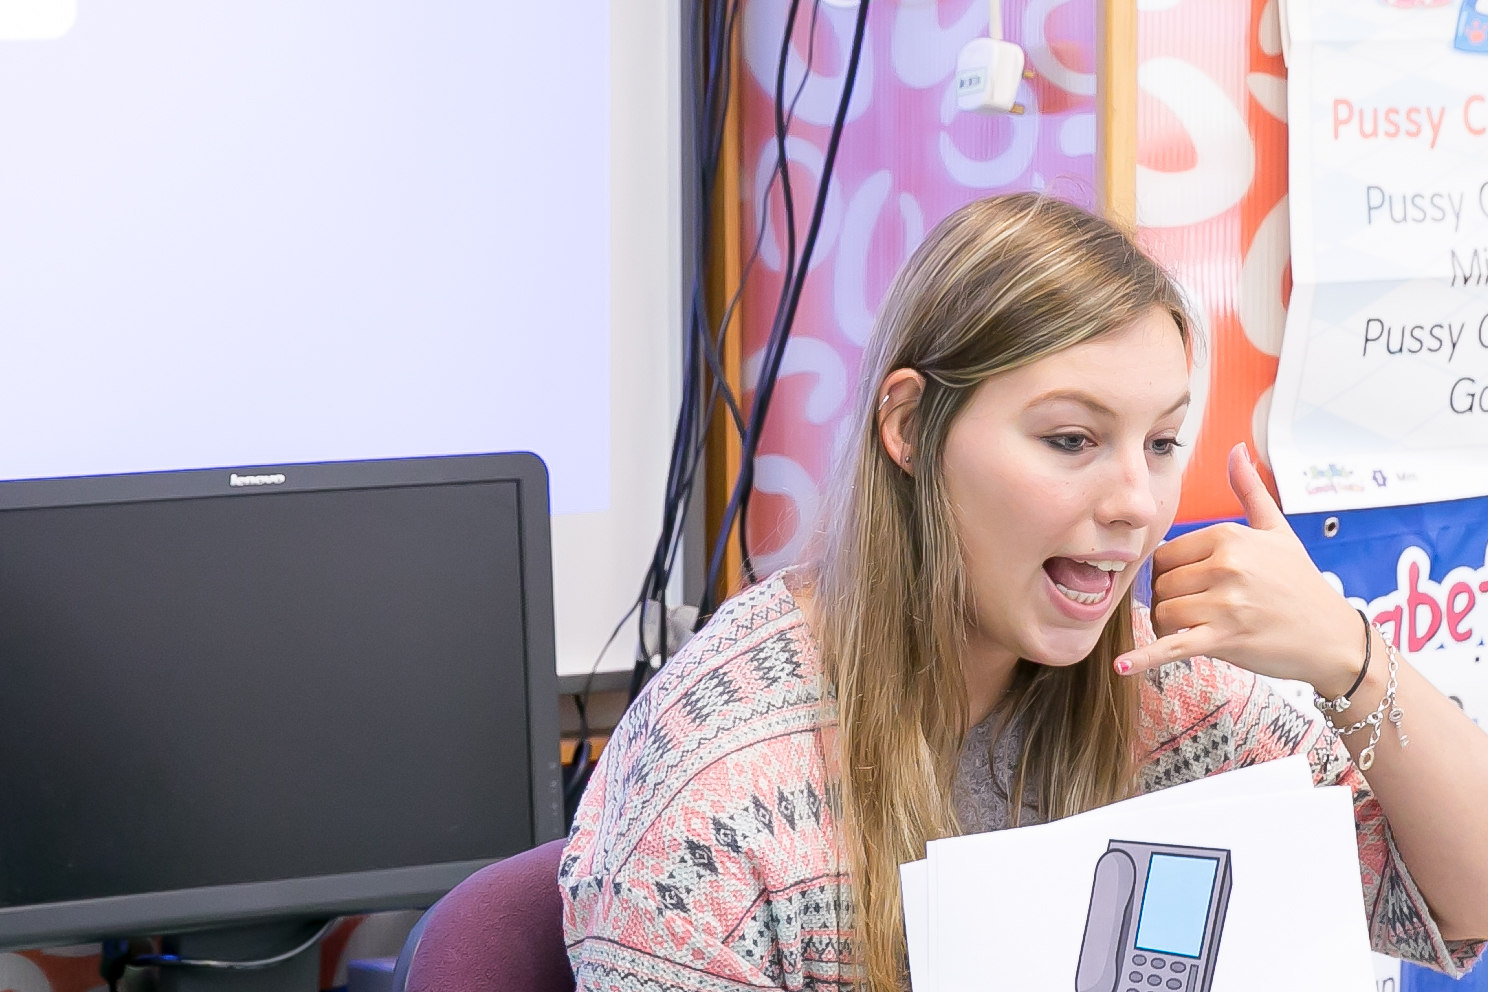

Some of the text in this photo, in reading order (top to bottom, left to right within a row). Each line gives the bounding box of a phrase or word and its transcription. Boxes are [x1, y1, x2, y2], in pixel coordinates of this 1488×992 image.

[1332, 98, 1446, 150] Pussy
[1366, 184, 1464, 232] Pussy
[1362, 317, 1465, 363] Pussy
